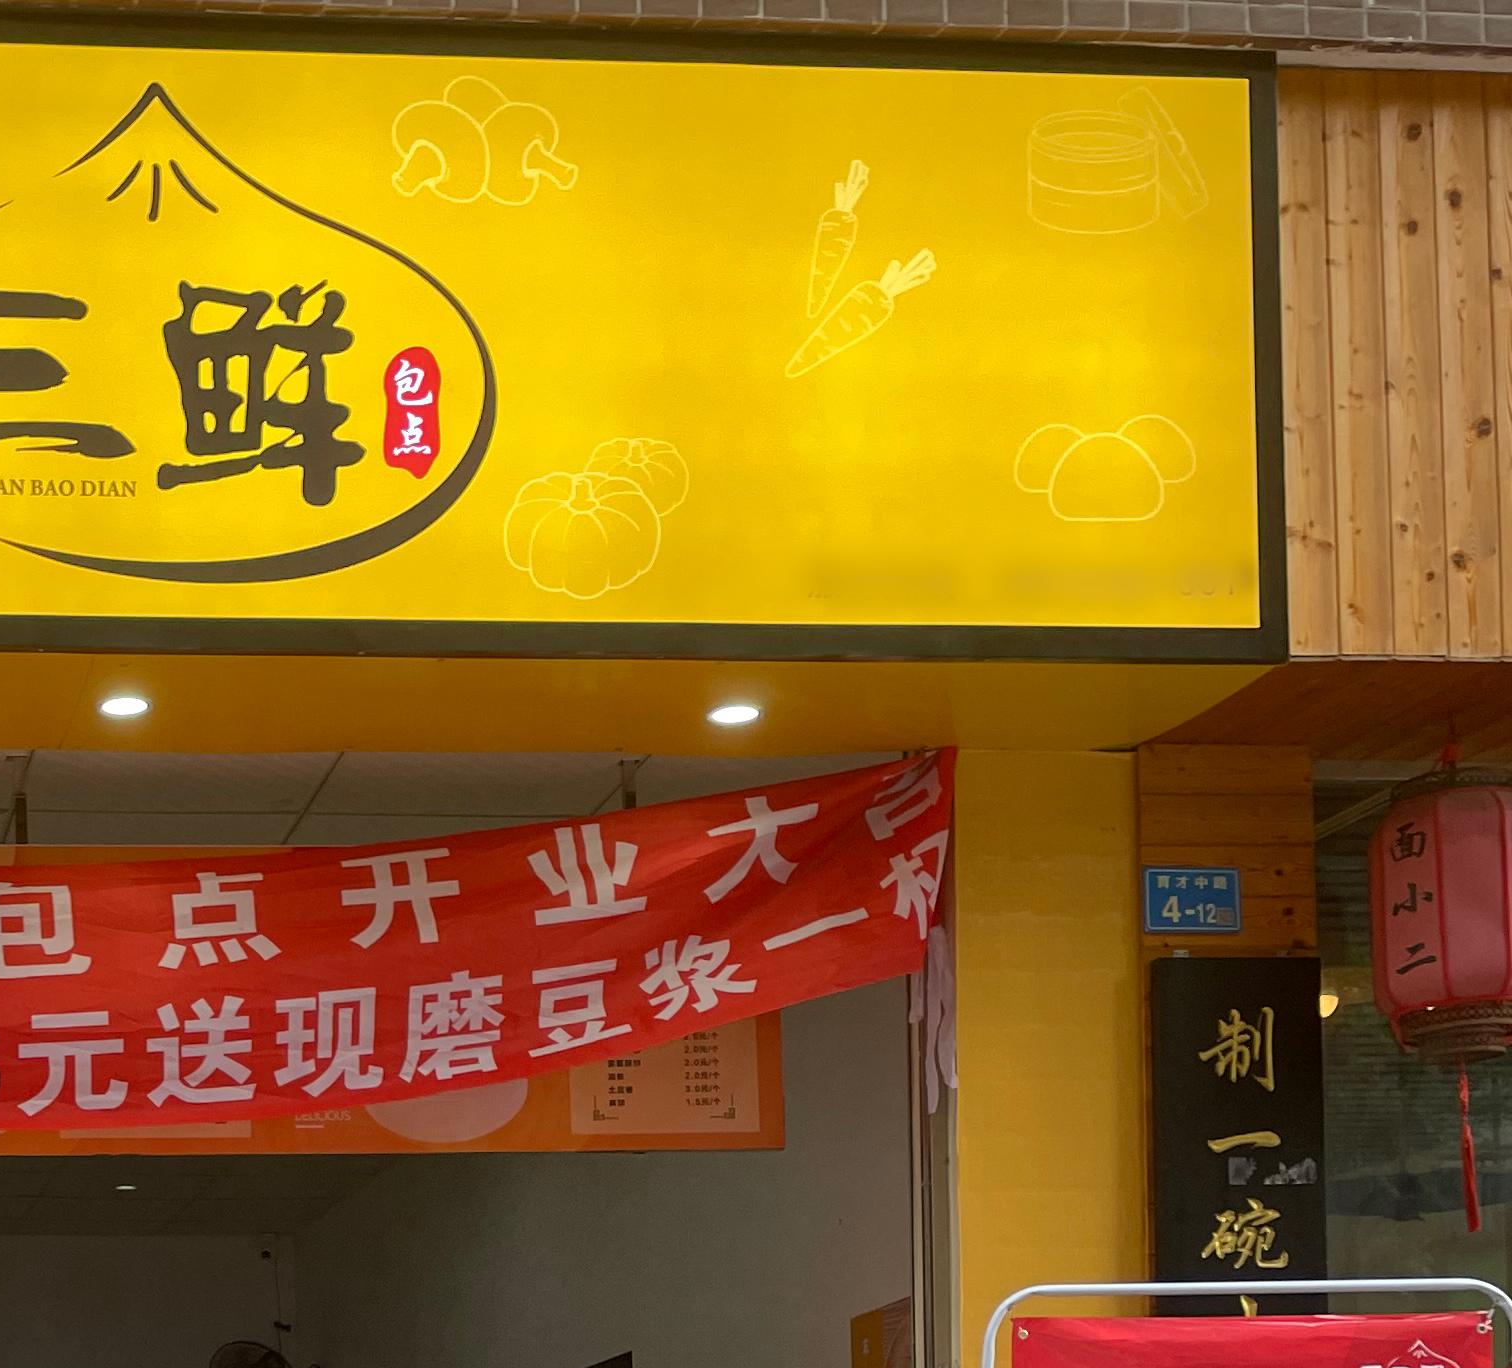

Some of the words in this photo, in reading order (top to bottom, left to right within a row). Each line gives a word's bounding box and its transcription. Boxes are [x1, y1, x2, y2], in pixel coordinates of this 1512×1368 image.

[393, 358, 434, 456] 包点
[30, 479, 75, 496] BAO
[80, 480, 137, 498] DIAN
[1161, 895, 1217, 924] 4-12
[1392, 822, 1437, 975] 面小二
